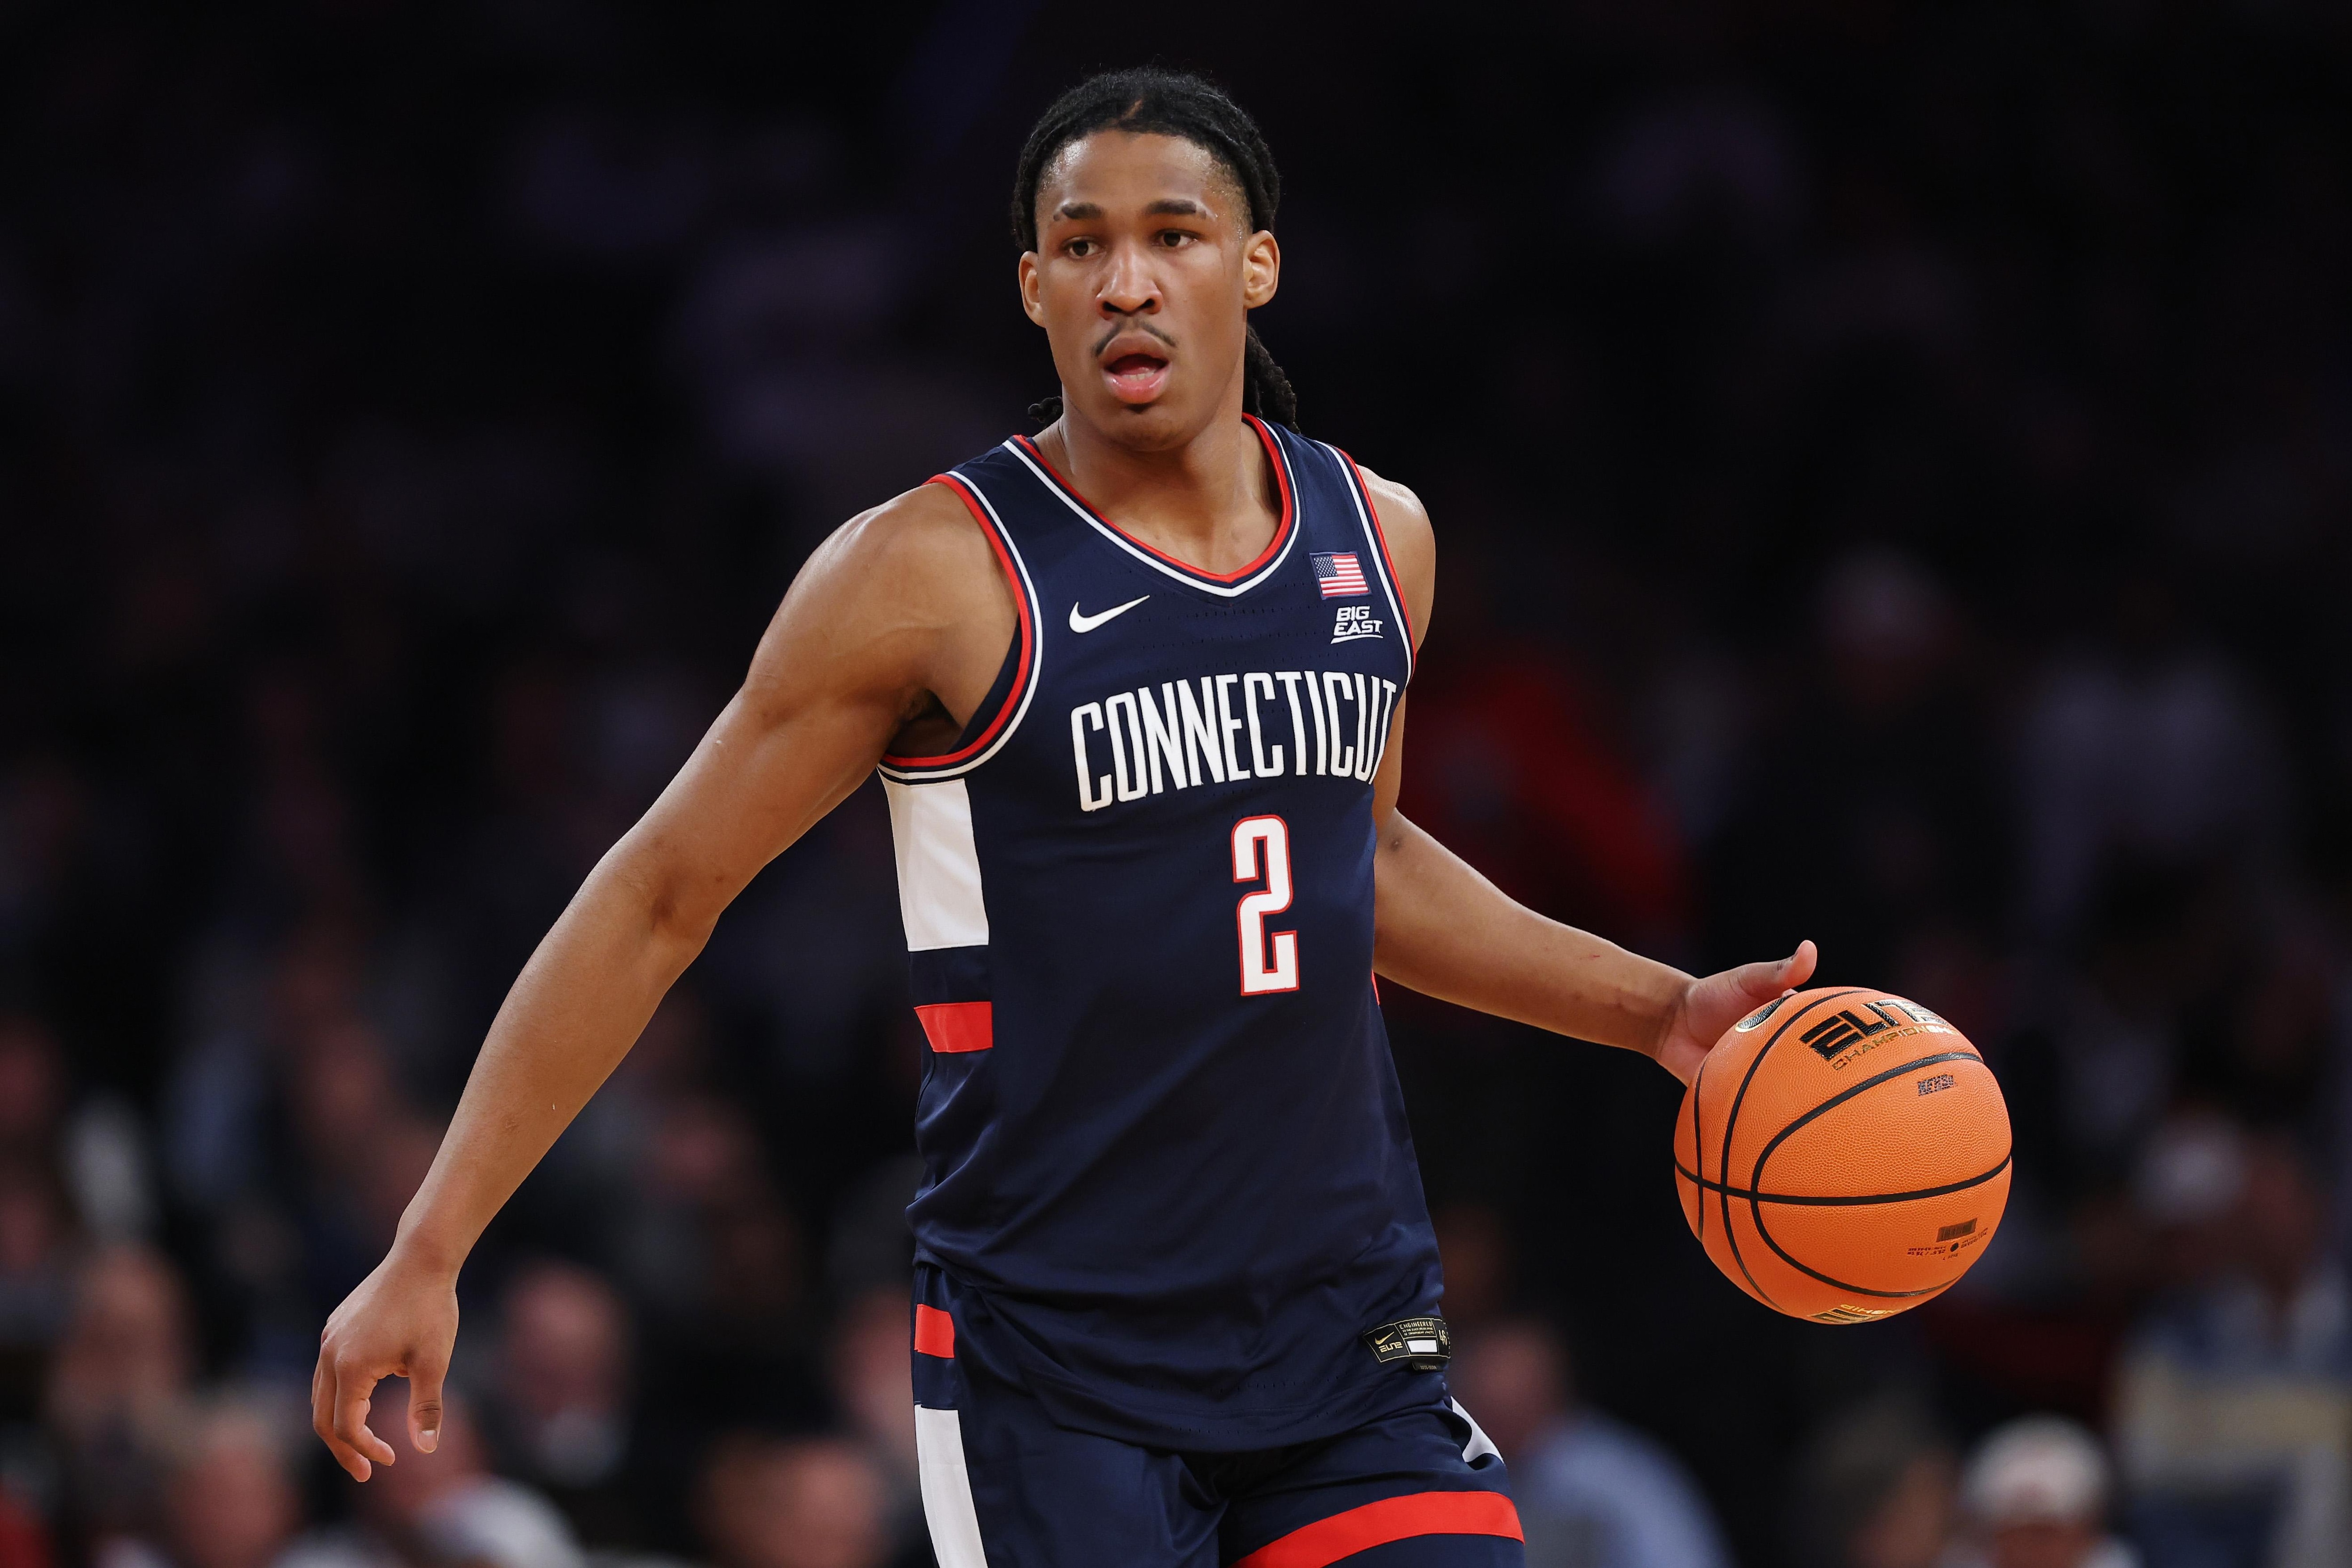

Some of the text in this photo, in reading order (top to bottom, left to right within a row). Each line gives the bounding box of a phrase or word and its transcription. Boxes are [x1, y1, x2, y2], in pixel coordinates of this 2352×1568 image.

[1336, 606, 1370, 621] BIG
[1334, 620, 1383, 636] EAST
[1071, 671, 1397, 812] CONNECTICUT
[1231, 814, 1299, 996] 2
[1800, 999, 1950, 1061] ELITE
[1399, 1321, 1432, 1330] ENGINEERED
[1438, 1329, 1447, 1346] 46
[1378, 1341, 1403, 1353] ELITE
